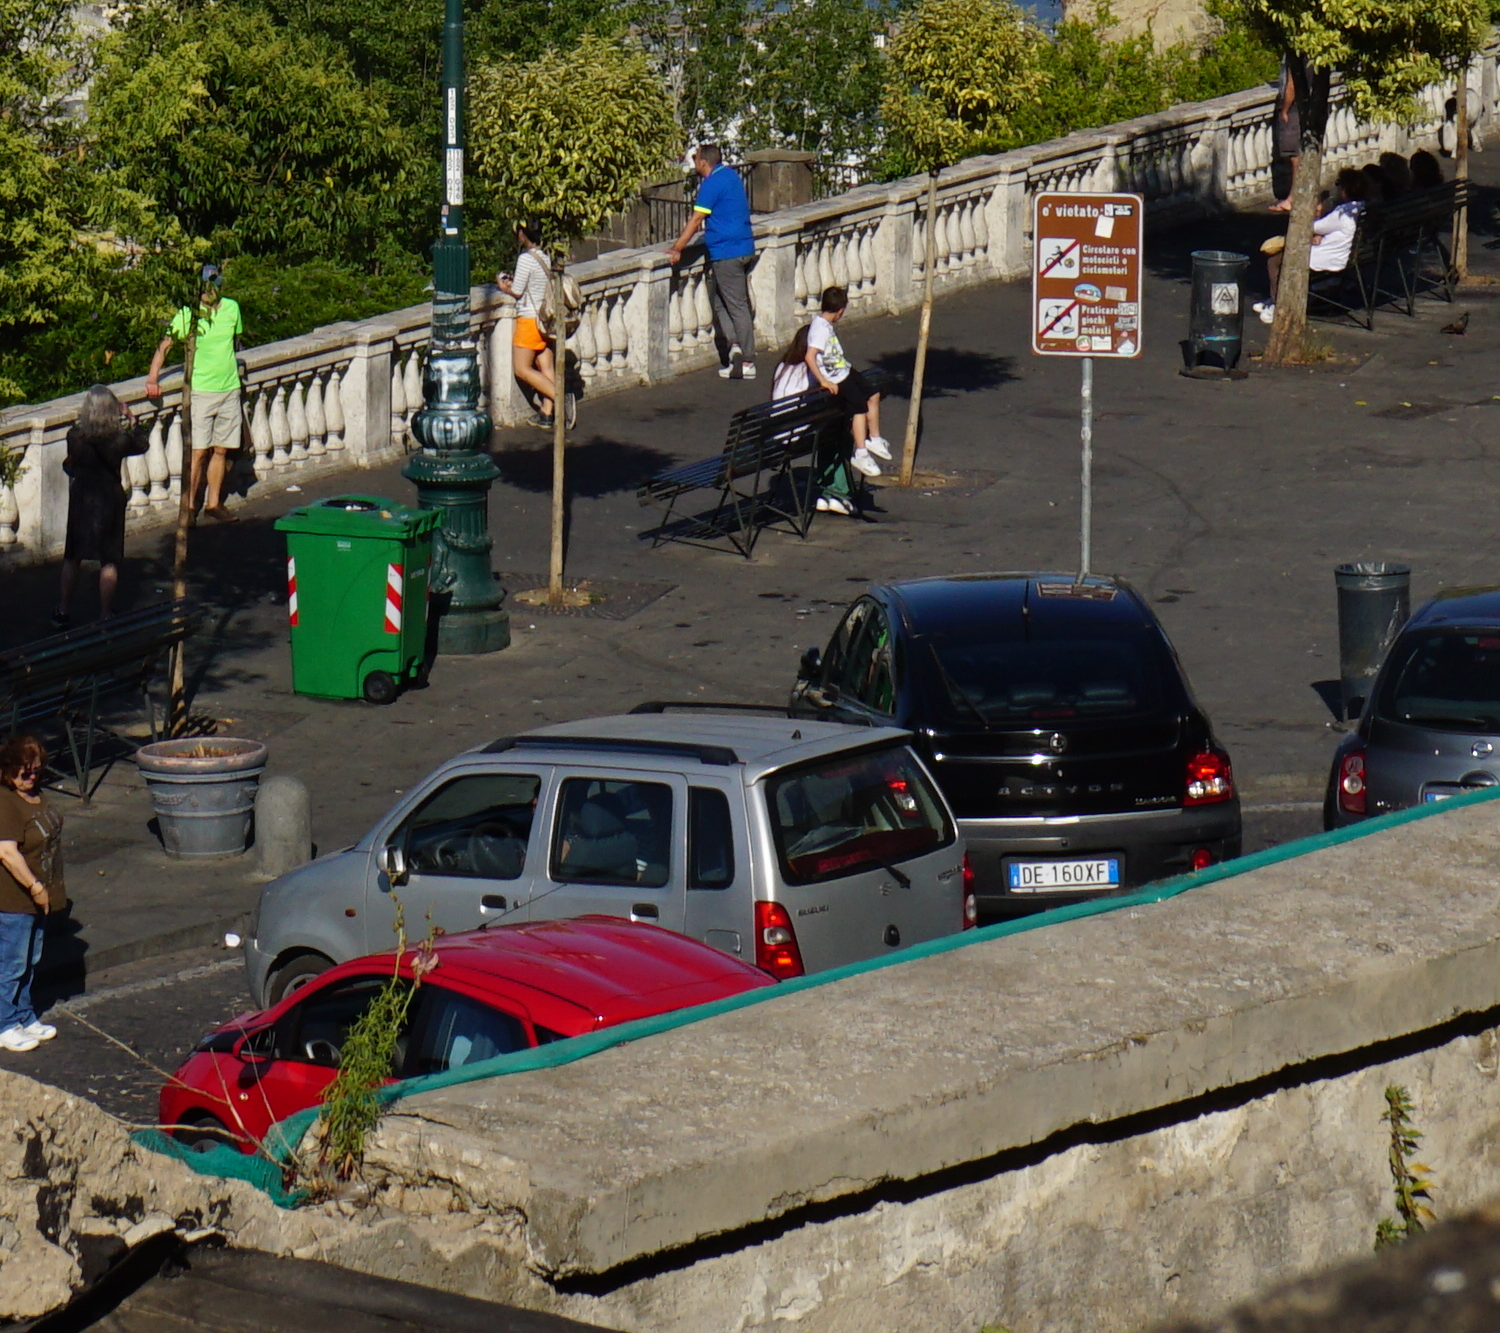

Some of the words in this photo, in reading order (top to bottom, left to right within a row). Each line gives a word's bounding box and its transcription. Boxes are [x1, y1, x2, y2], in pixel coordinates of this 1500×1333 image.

[1082, 244, 1120, 255] Circolare
[1121, 247, 1137, 256] con
[1082, 255, 1120, 265] motocicli
[1081, 265, 1128, 276] ciclomotori
[1081, 305, 1119, 316] Praticare
[1081, 315, 1106, 326] giochi
[1081, 325, 1112, 336] molesti
[1051, 862, 1106, 883] 160XF
